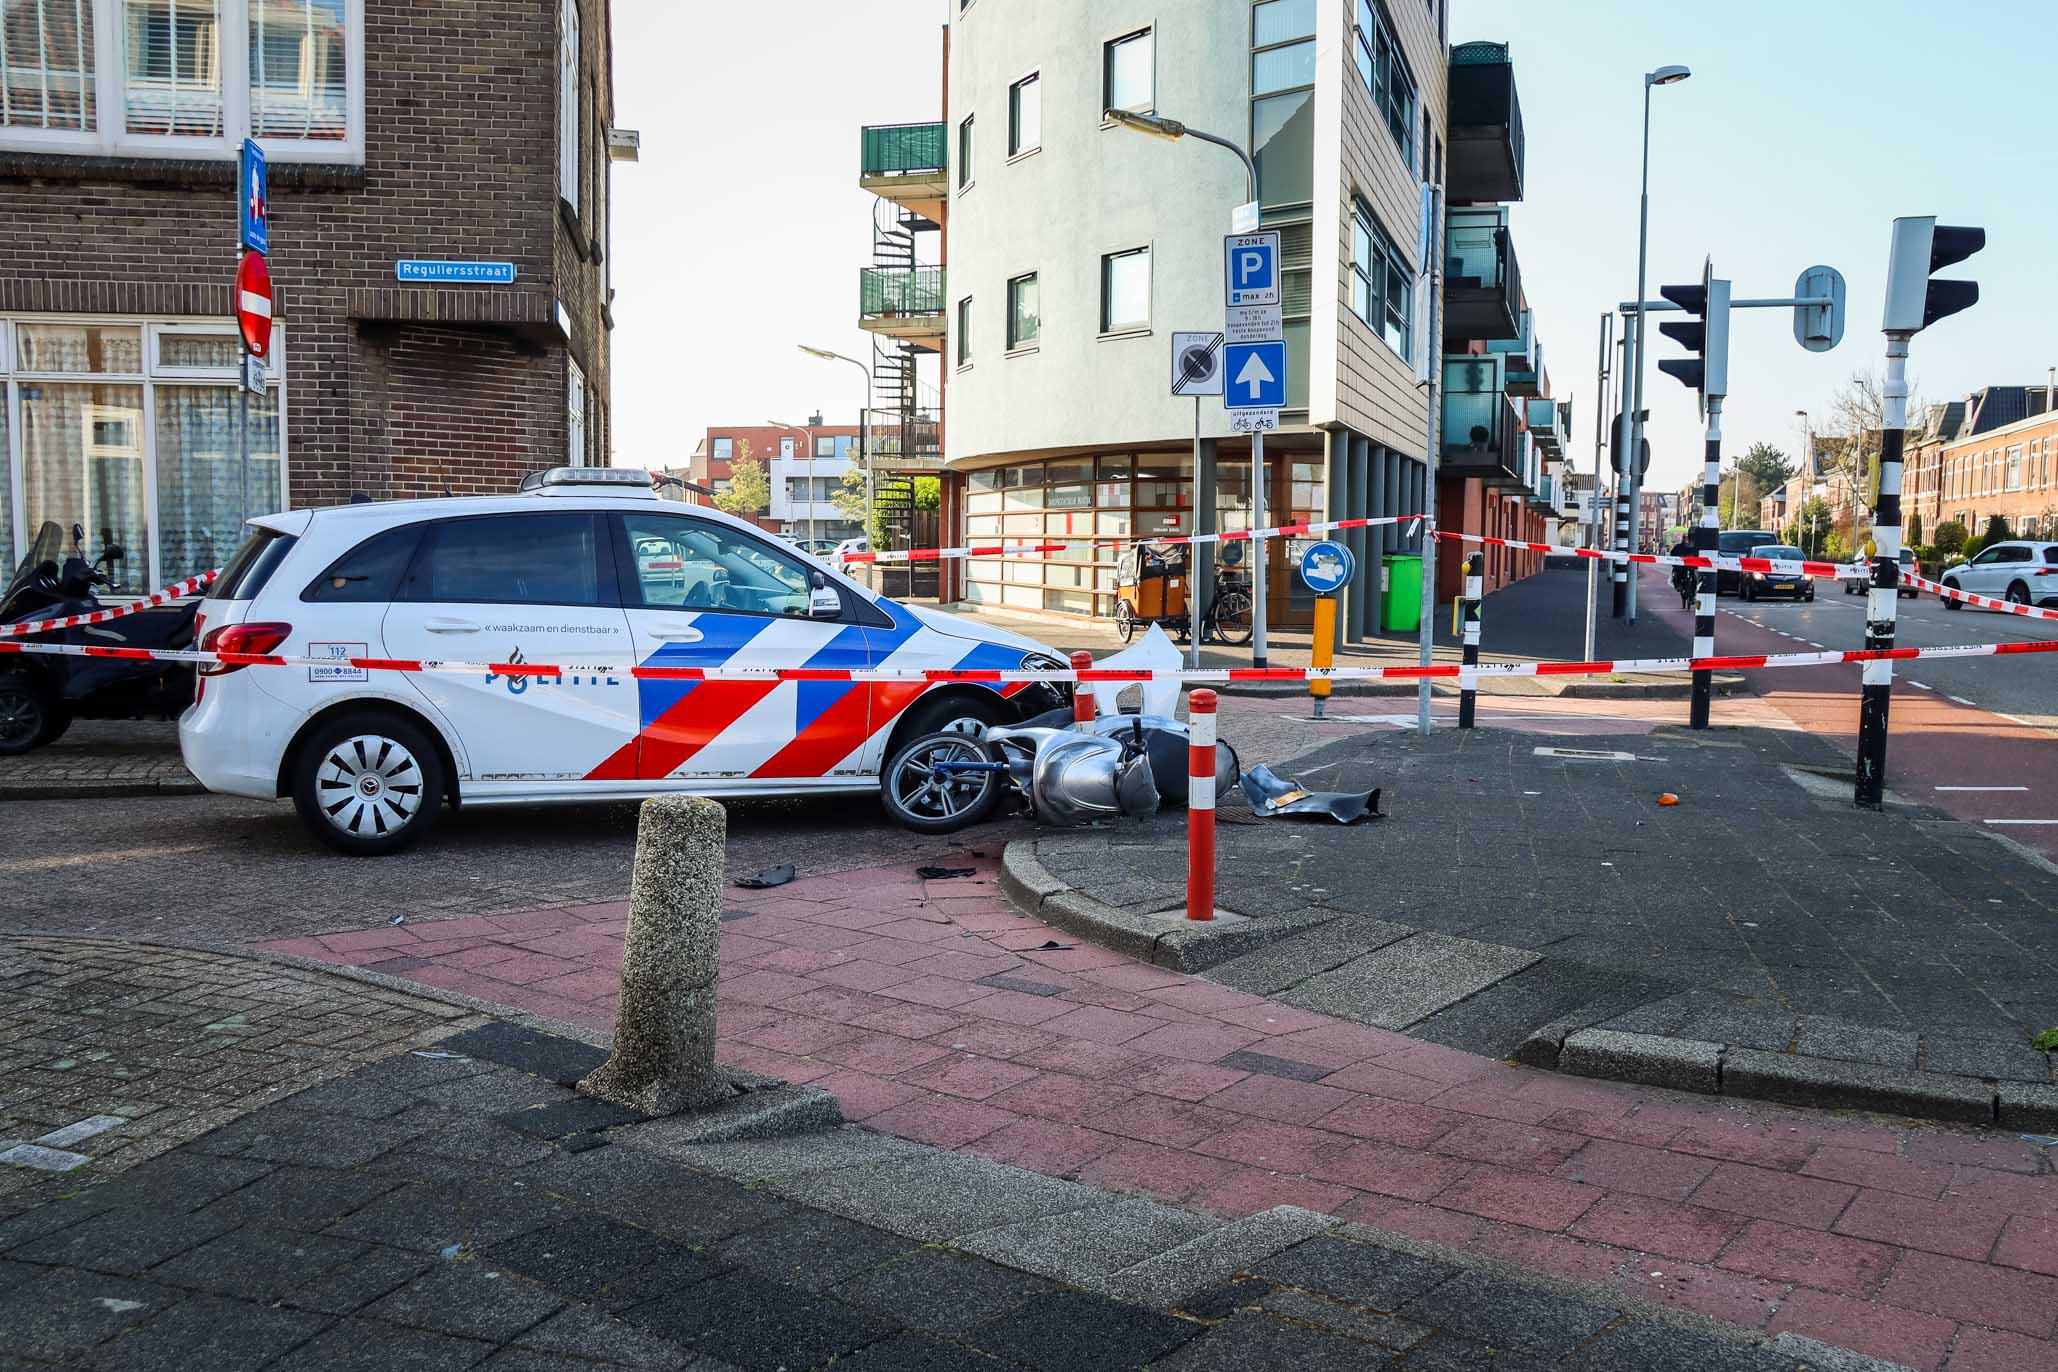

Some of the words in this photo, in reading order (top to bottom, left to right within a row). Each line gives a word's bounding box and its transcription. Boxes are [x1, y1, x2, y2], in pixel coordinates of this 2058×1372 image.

[1237, 237, 1265, 247] ZONE
[402, 263, 508, 277] Reguliersstraat
[1241, 251, 1263, 285] P
[1242, 293, 1260, 301] max
[493, 624, 545, 633] waakzaam
[560, 624, 611, 634] dienstbaar
[329, 647, 346, 656] 112
